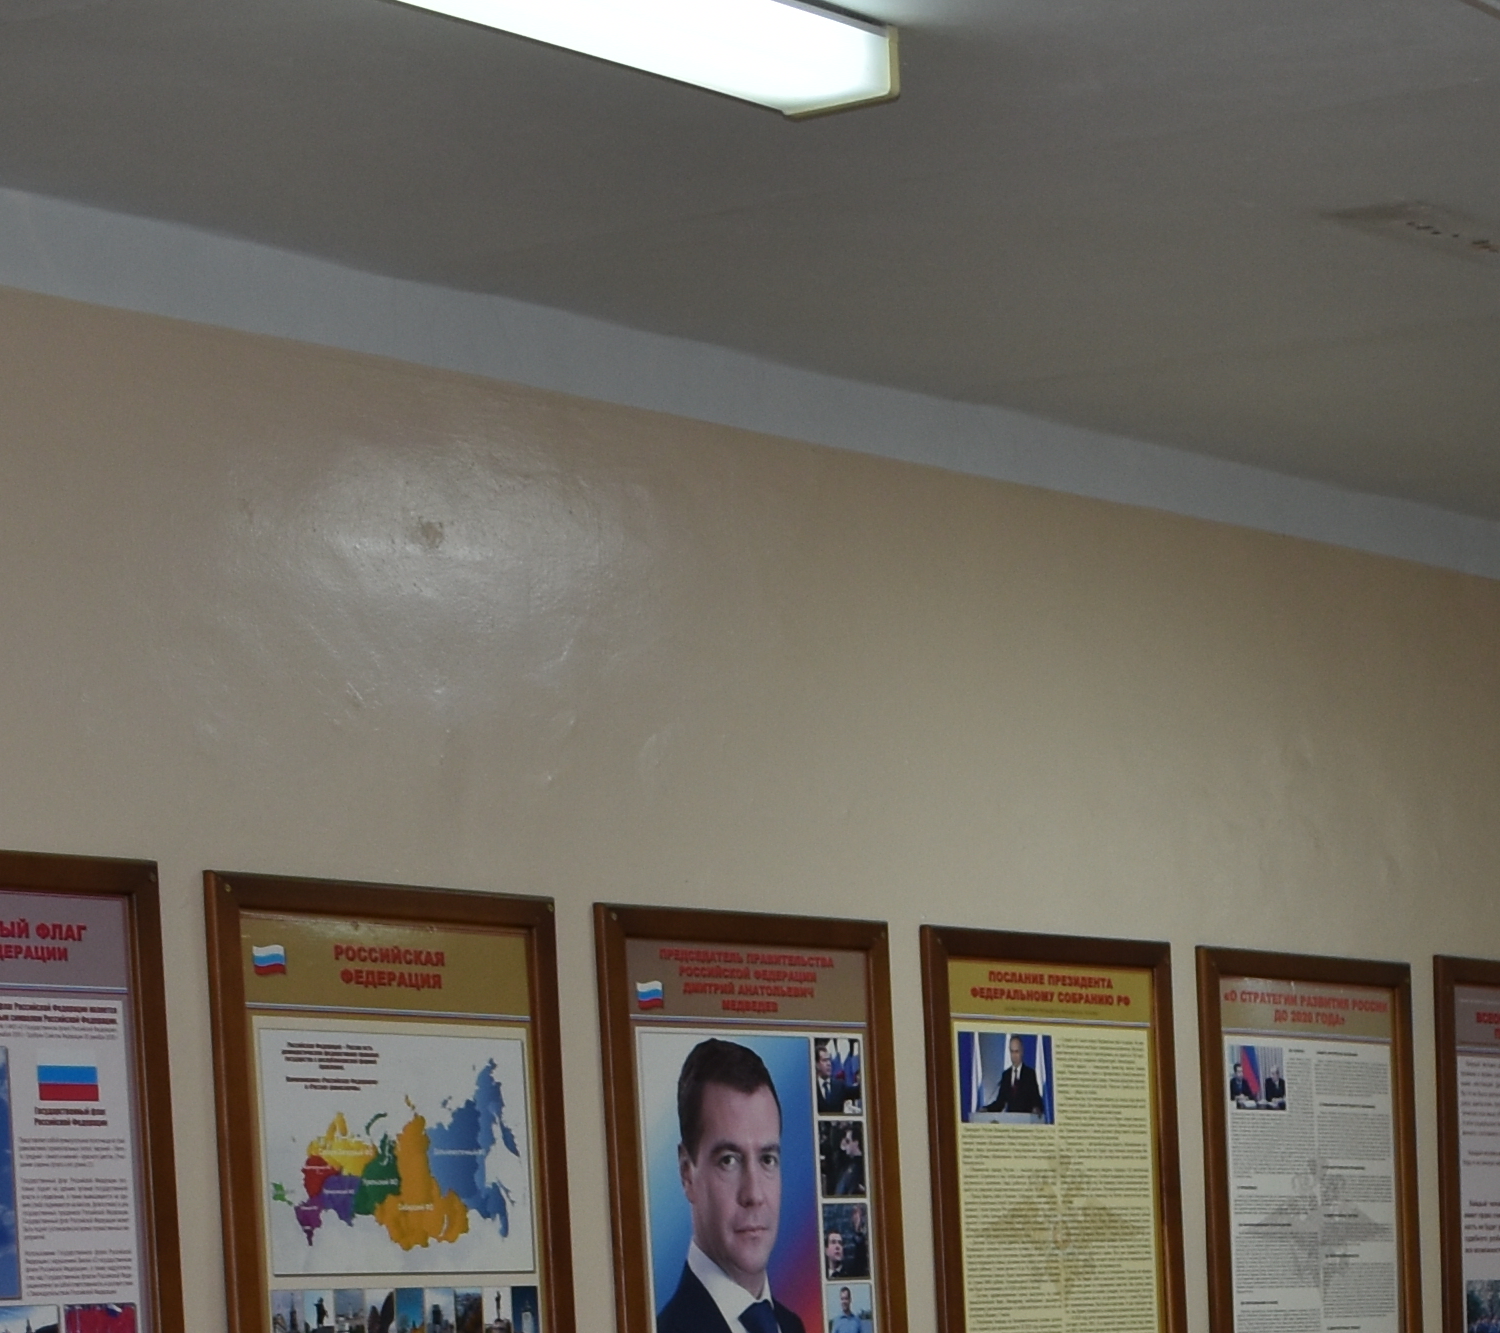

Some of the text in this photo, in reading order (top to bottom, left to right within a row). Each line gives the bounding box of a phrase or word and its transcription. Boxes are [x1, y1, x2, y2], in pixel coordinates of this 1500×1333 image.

[36, 923, 86, 941] ФЛАГ
[334, 945, 445, 966] РОССИЙСКАЯ
[659, 948, 834, 968] ПРЕДСЕДАТЕЛЬ ПРАВИТЕЛЬСТВА
[341, 968, 443, 990] ФЕДЕРАЦИЯ
[679, 965, 817, 983] РОССИЙСКОЙ ФЕДЕРАЦИИ
[989, 971, 1113, 989] ПОСЛАНИЕ ПРЕЗИДЕНТА
[683, 982, 814, 998] ДМИТРИЙ АНАТОЛЬЕВИЧ
[971, 987, 1130, 1006] ФЕДЕРАЛЬНОМУ СОБРАНИЮ РФ
[722, 999, 778, 1014] МЕДВЕДЕВ
[1224, 990, 1388, 1012] «О СТРАТЕГИИ РАЗВИТИЯ РОССИИ
[1274, 1010, 1288, 1023] ДО
[1291, 1011, 1312, 1023] 2020
